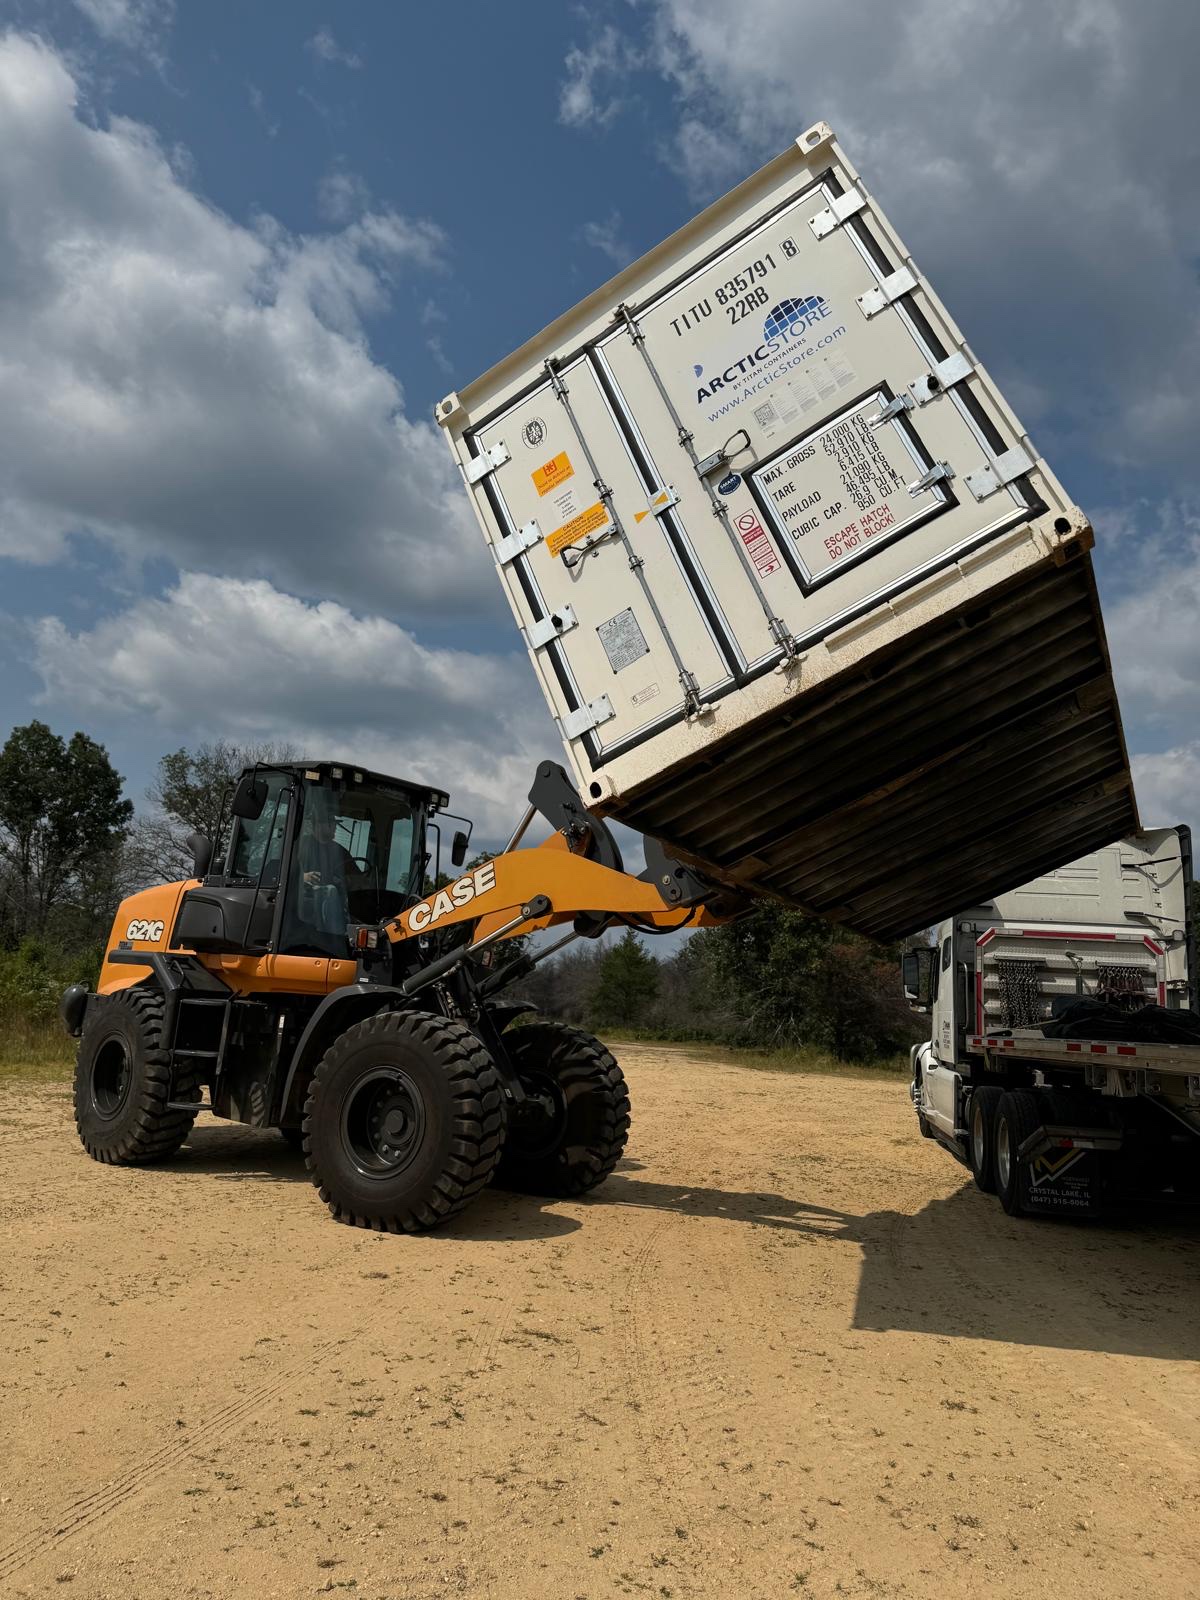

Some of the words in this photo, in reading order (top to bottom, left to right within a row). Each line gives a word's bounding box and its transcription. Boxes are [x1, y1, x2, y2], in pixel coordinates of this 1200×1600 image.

[669, 299, 713, 337] TITU
[714, 253, 777, 306] 835791
[781, 239, 798, 258] 8
[726, 286, 770, 325] 22RB
[696, 302, 833, 404] ARCTICSTORE
[707, 324, 847, 423] www.ArcticStore.com
[732, 382, 742, 391] BY
[742, 368, 763, 384] TITAN
[764, 337, 807, 370] CONTAINERS
[787, 445, 816, 469] GROSS
[850, 413, 864, 427] KG
[855, 422, 869, 437] LB
[865, 441, 879, 456] LB
[772, 481, 797, 503] TARE
[860, 431, 875, 446] KG
[781, 491, 822, 522] PAYLOAD
[871, 451, 885, 466] KG
[876, 460, 891, 475] LB
[562, 515, 584, 531] CAUTION
[791, 517, 820, 541] CUBIC
[823, 501, 847, 521] CAP.
[850, 485, 871, 504] 26.9
[857, 494, 876, 511] 950
[823, 521, 859, 550] ESCAPE
[861, 504, 891, 526] HATCH
[828, 545, 844, 560] DO
[843, 533, 862, 550] NOT
[864, 515, 896, 538] BLOCK!
[408, 860, 497, 932] CASE
[126, 919, 165, 942] 621G
[1028, 1186, 1060, 1196] CRYSTAL
